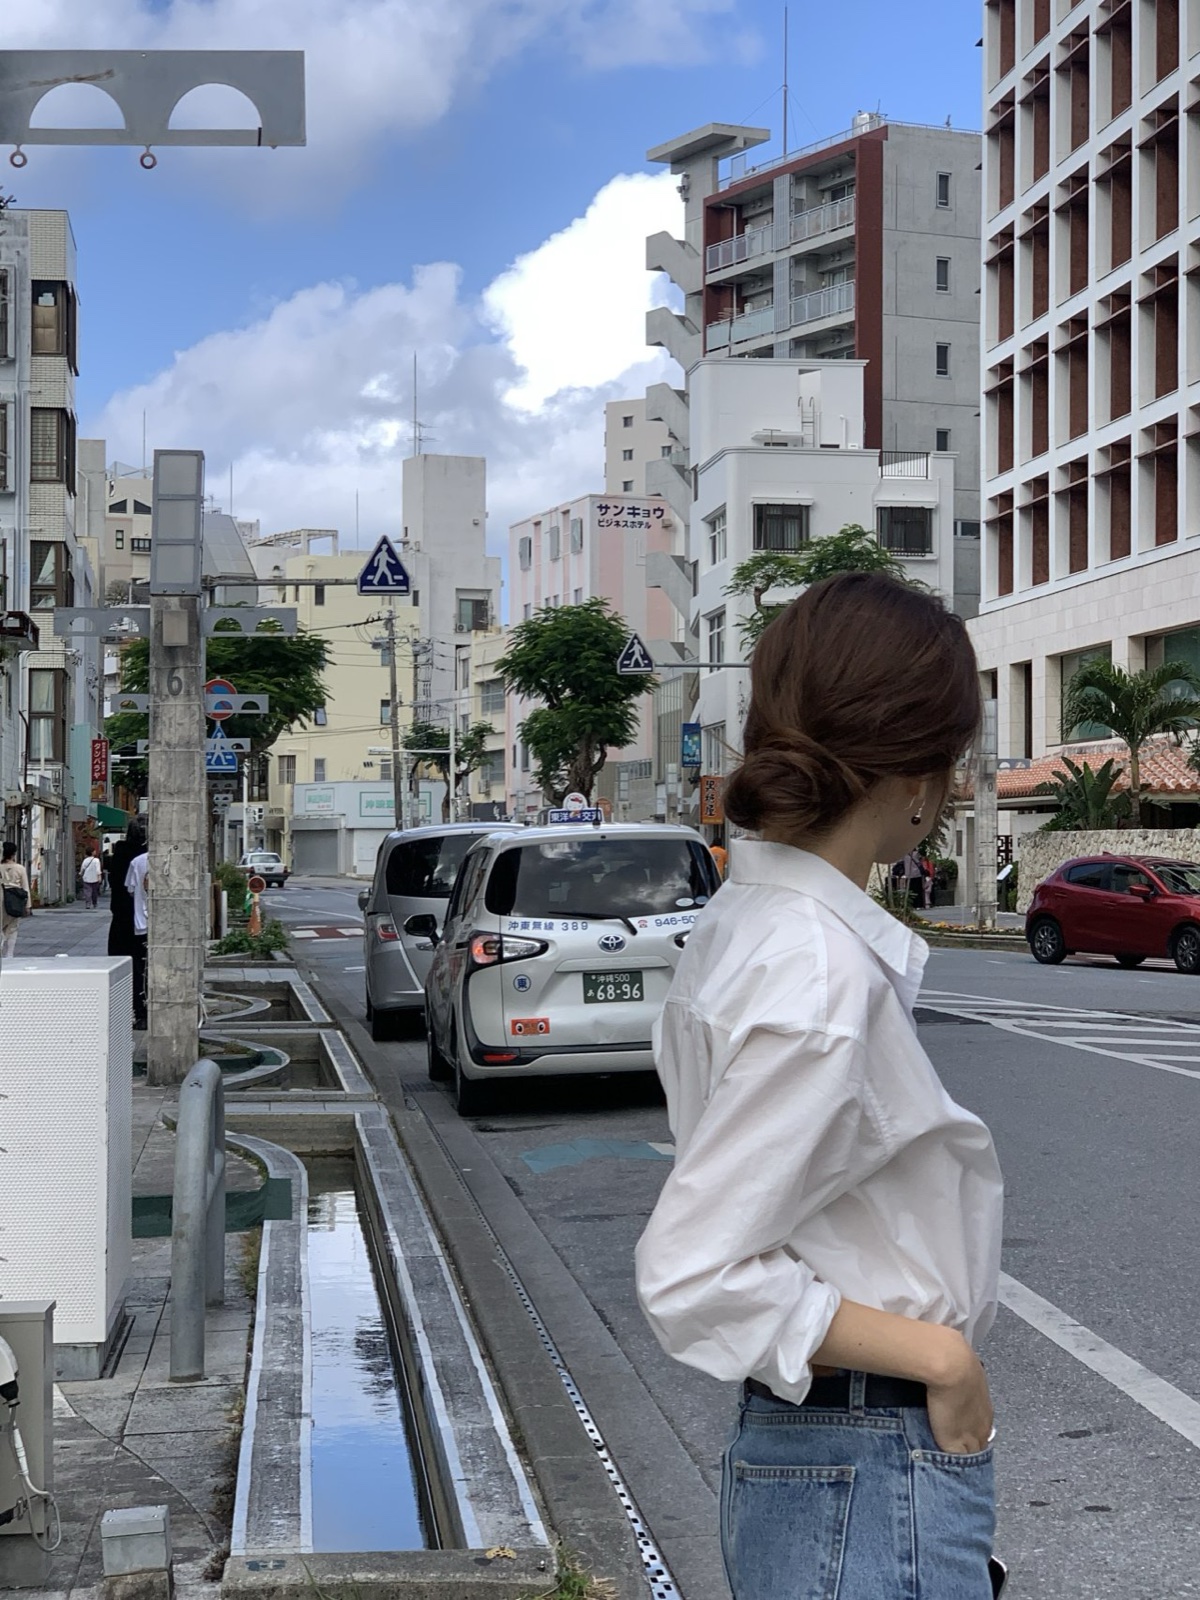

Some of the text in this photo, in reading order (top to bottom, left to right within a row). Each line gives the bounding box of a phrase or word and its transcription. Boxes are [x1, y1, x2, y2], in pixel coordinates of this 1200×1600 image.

[596, 504, 665, 519] サンキョウ
[597, 518, 652, 529] ビジネスホテル
[166, 667, 183, 696] 6
[508, 921, 588, 931] 沖東無線 389
[654, 914, 699, 927] 946-50
[516, 977, 528, 989] 東
[596, 983, 641, 1000] 68-96
